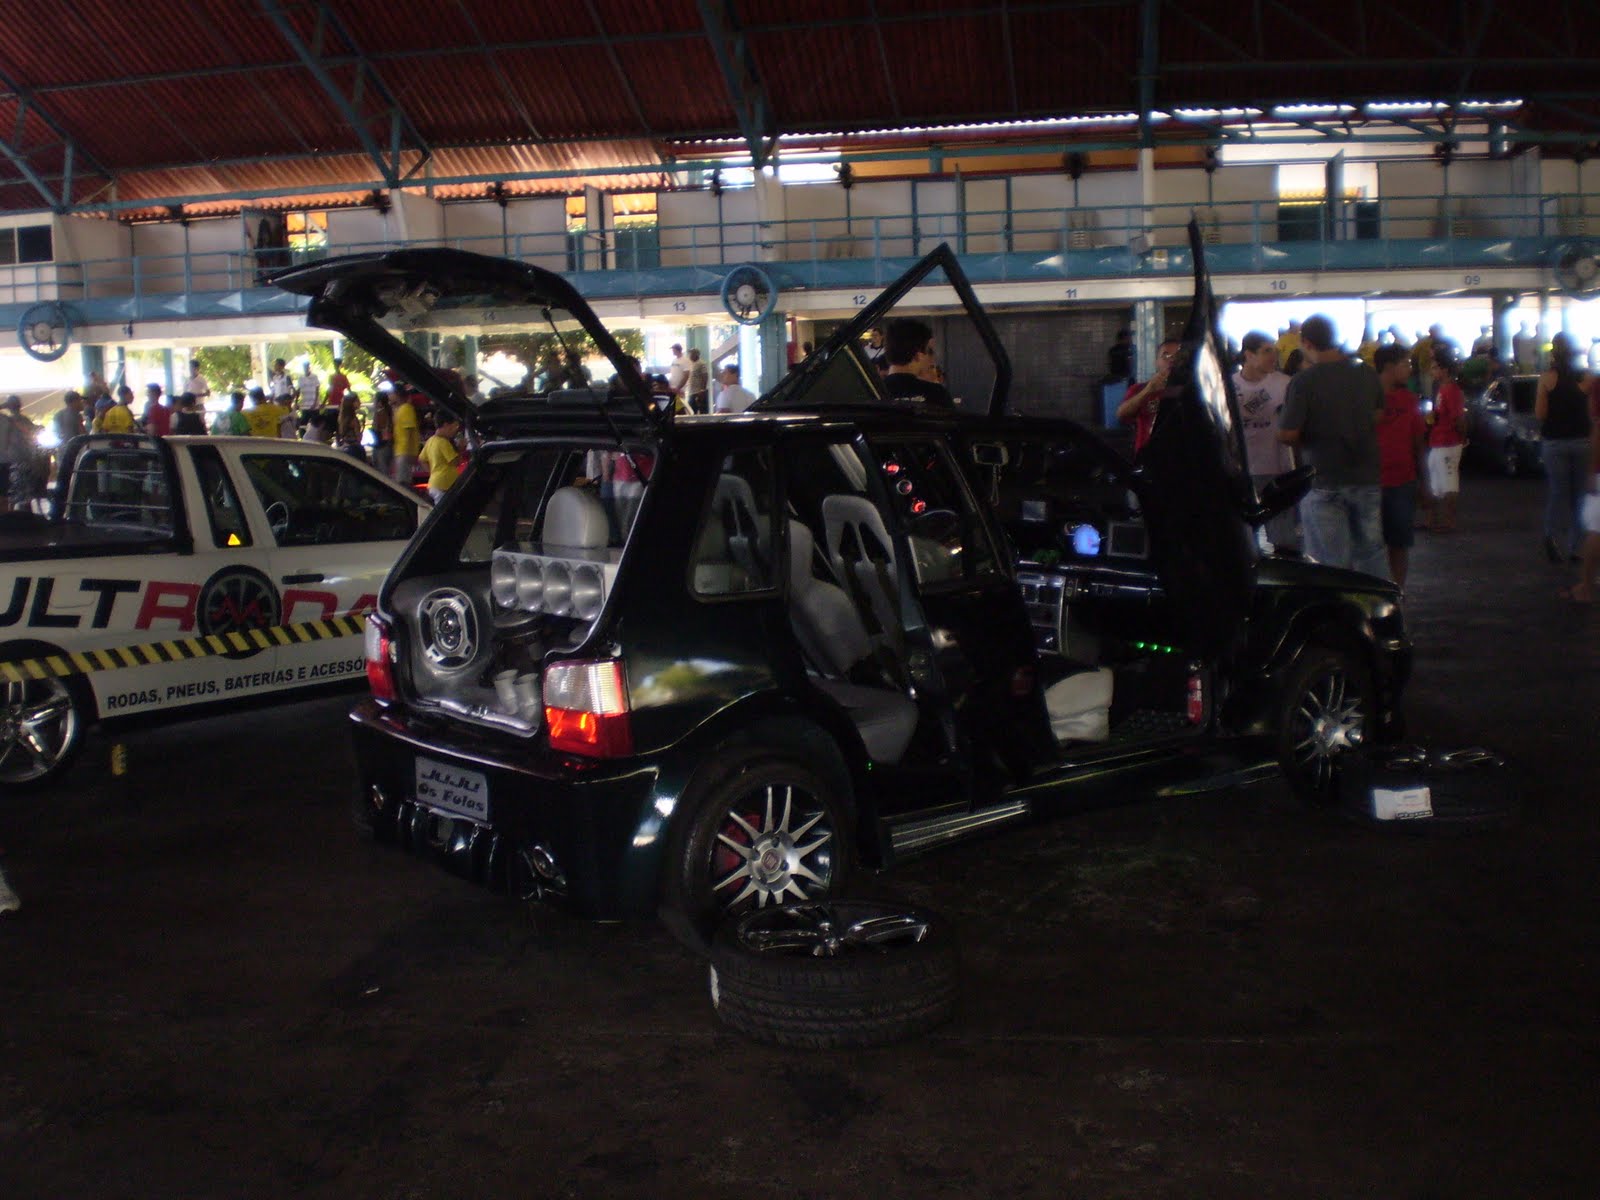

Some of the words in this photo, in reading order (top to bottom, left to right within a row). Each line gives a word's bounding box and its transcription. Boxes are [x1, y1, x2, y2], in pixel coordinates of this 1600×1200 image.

[1270, 279, 1287, 290] 10
[1464, 275, 1480, 285] 09
[1065, 288, 1078, 299] 11
[852, 294, 867, 305] 12
[672, 301, 687, 312] 13
[107, 688, 162, 710] RODAS,
[166, 680, 220, 700] PNEUS,
[224, 668, 293, 691] BATERIAS
[298, 667, 306, 680] E
